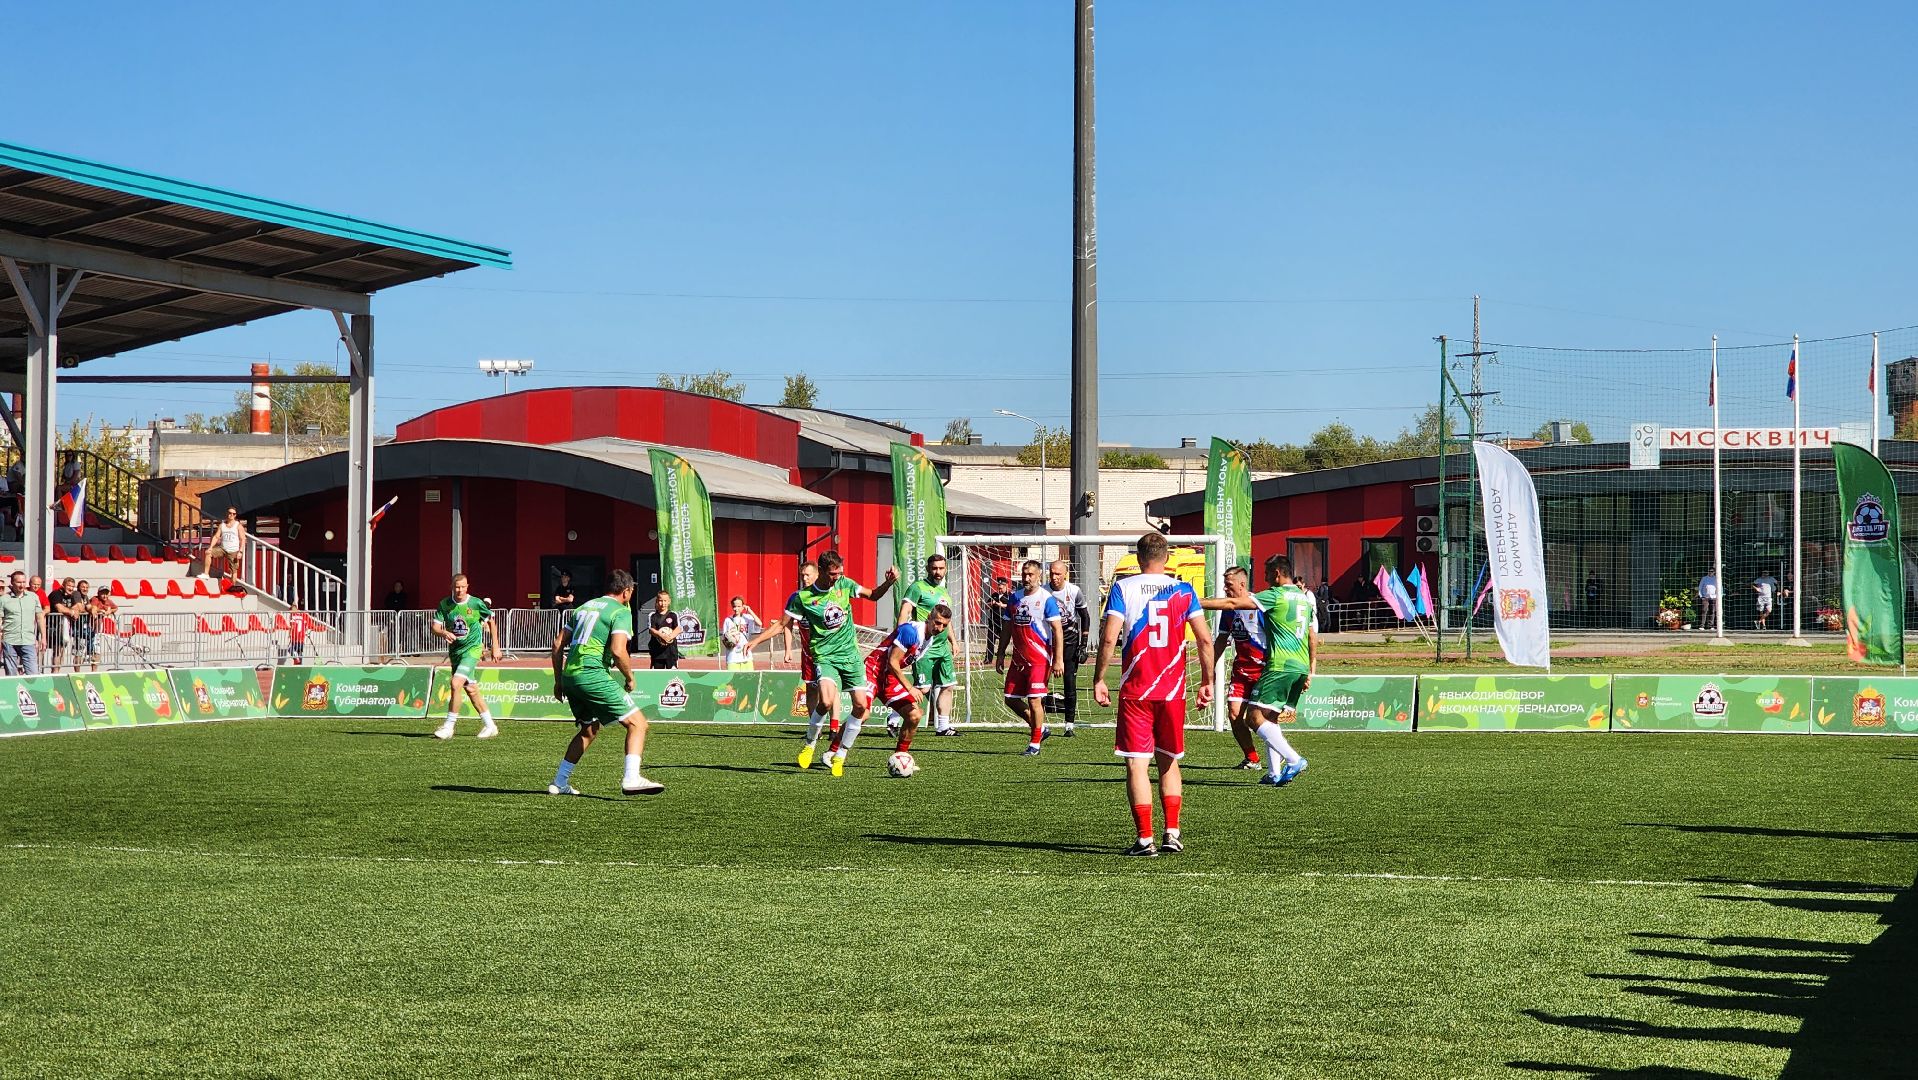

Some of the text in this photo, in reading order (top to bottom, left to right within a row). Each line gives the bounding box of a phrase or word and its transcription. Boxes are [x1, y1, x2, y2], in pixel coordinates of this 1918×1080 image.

[1670, 430, 1830, 447] МОСКВИЧ
[1148, 600, 1169, 649] 5
[336, 683, 379, 693] Команда
[478, 682, 540, 694] ОДИВОДВОР
[334, 696, 396, 707] Губернатора
[1305, 694, 1354, 705] Команда
[1438, 691, 1545, 701] #ВЫХОДИВОДВОР
[1303, 708, 1376, 720] Губернатора
[1438, 704, 1584, 713] #КОМАНДАГУБЕРНАТОРА
